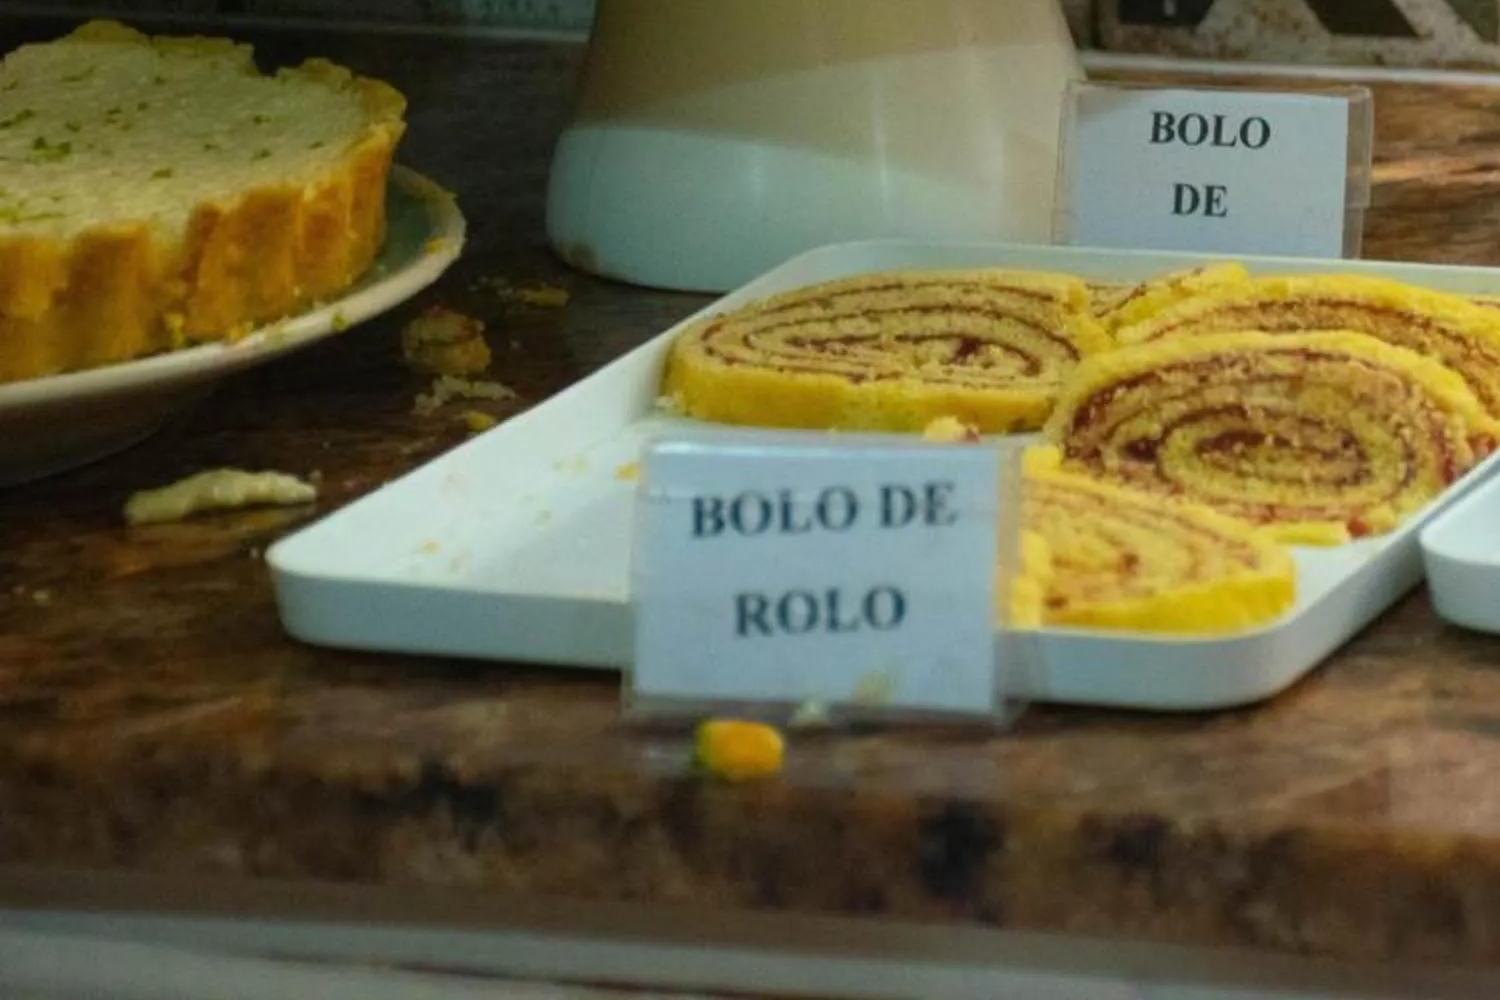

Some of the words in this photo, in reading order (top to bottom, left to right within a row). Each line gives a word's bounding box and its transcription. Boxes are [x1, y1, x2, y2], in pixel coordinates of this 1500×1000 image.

[1149, 111, 1271, 149] BOLO
[1172, 183, 1228, 217] DE
[692, 486, 860, 538] BOLO
[879, 481, 958, 530] DE
[734, 585, 907, 638] ROLO
